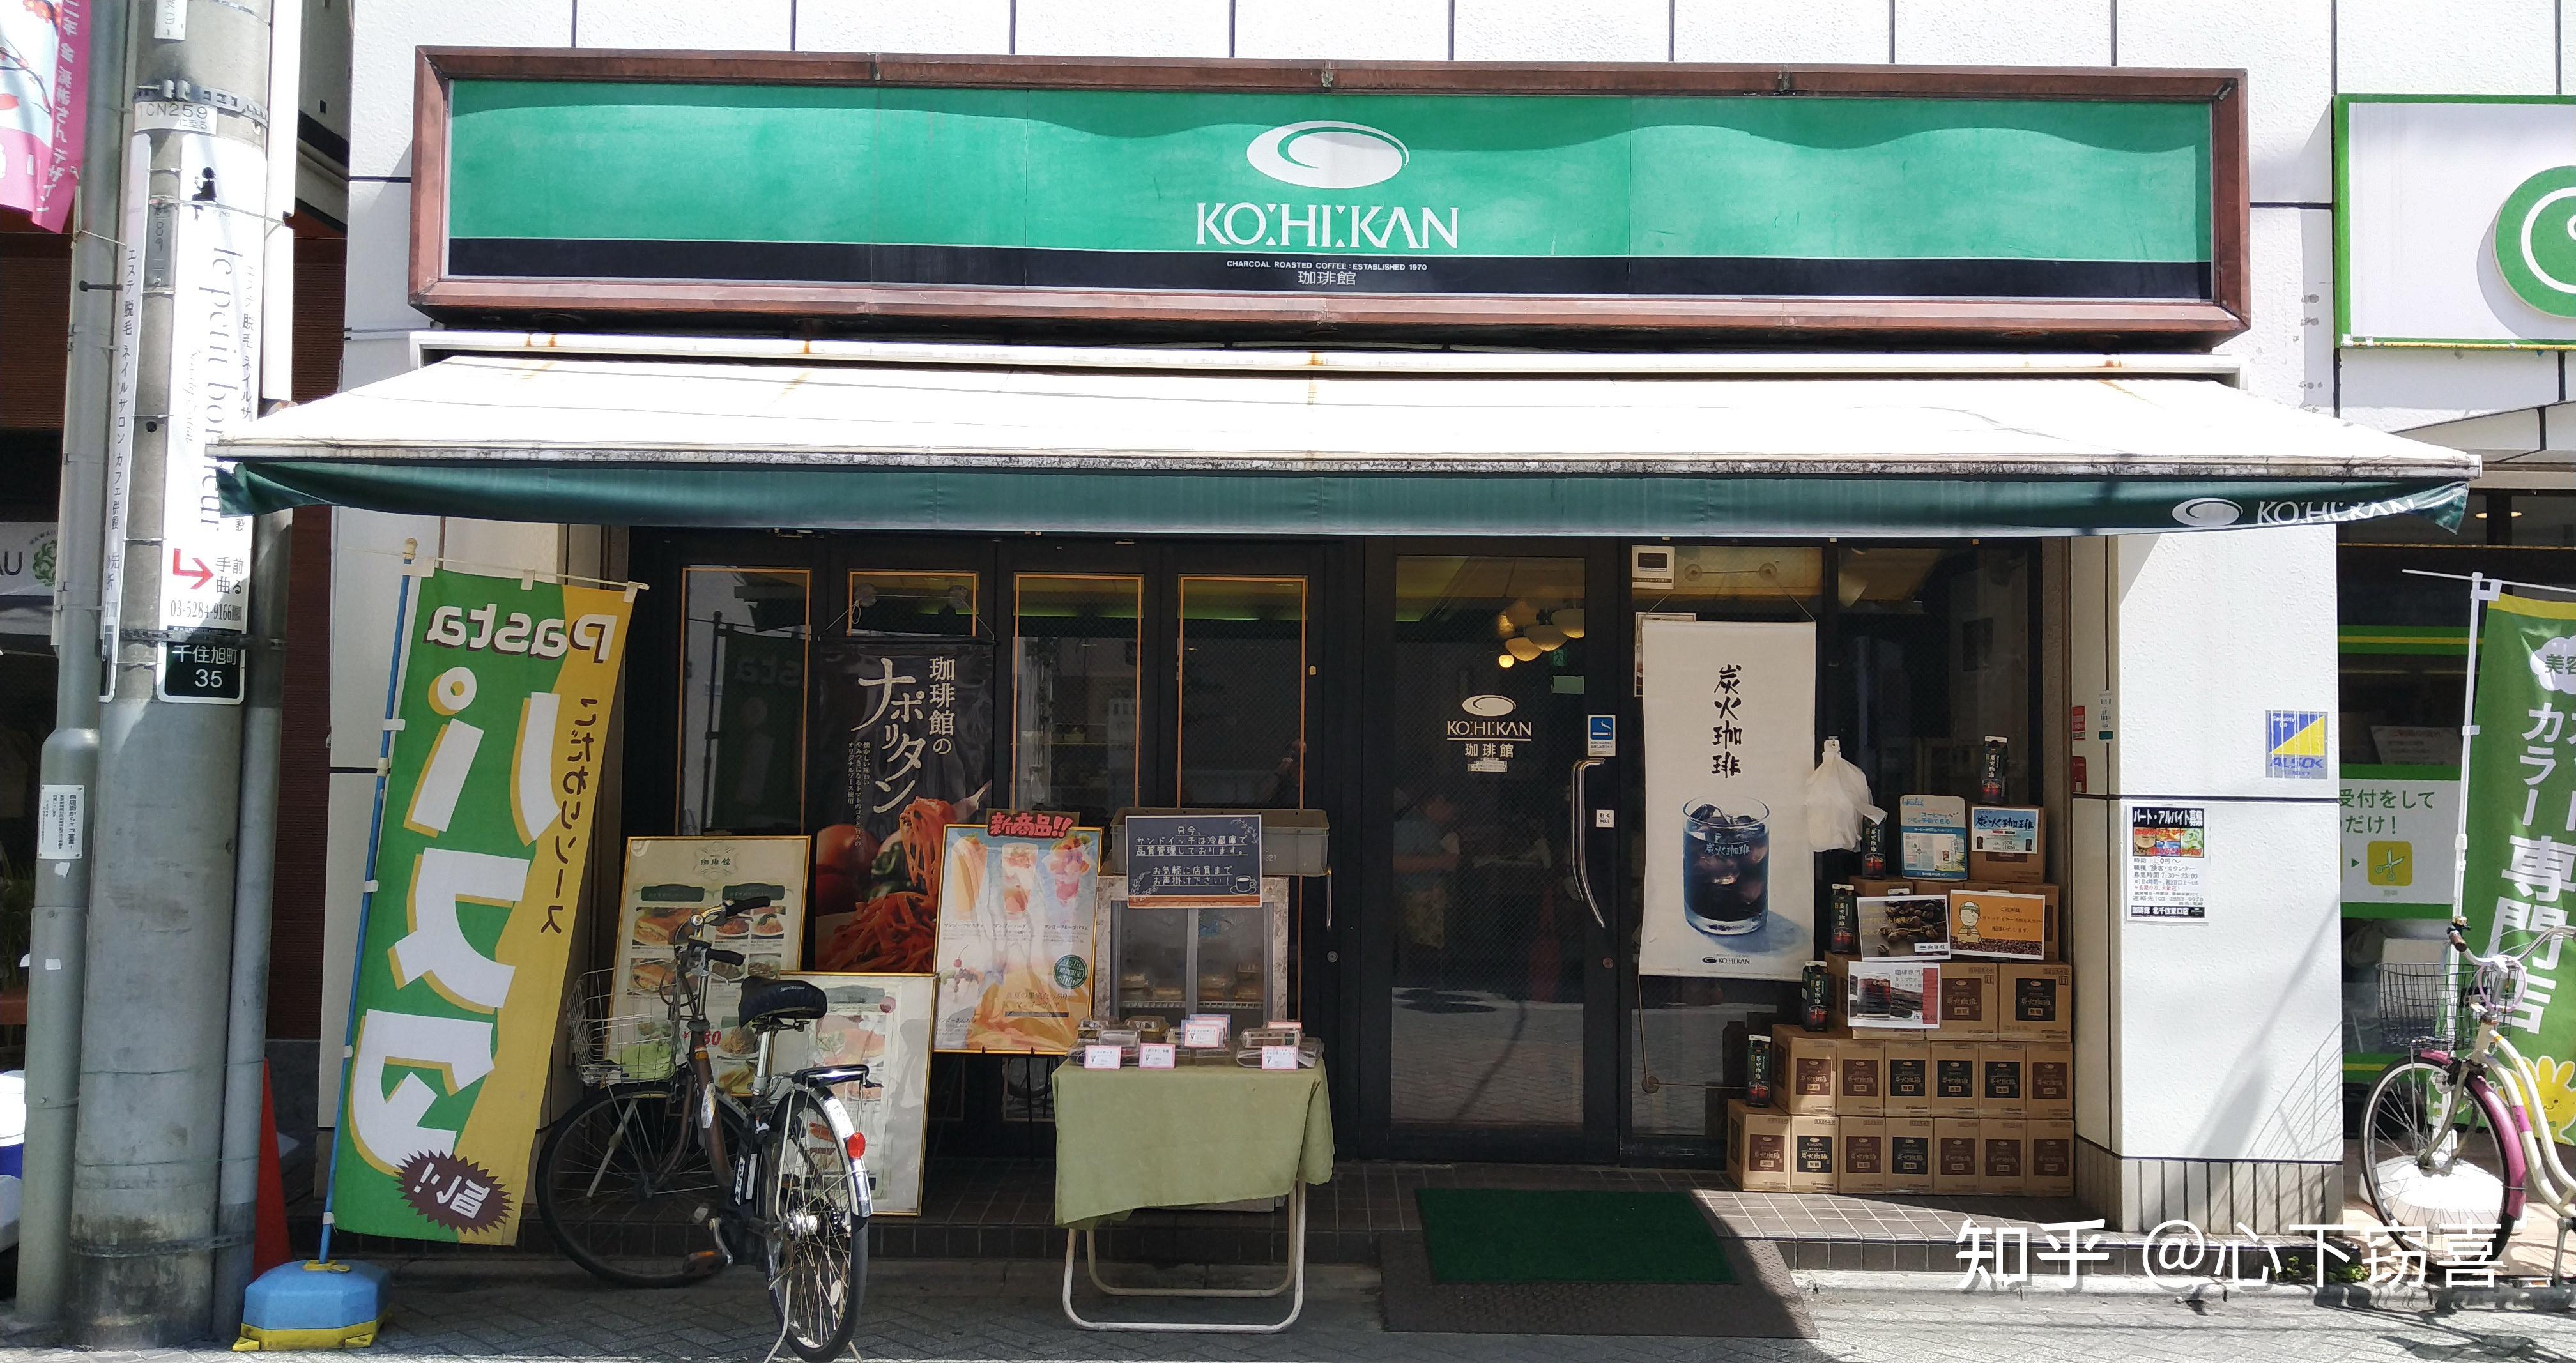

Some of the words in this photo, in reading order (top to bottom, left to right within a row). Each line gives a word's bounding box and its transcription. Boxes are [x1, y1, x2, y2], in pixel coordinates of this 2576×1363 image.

[1227, 260, 1271, 268] CHARCOAL
[1274, 261, 1312, 269] ROASTED
[1315, 262, 1347, 270] COFFEE
[1353, 263, 1406, 271] ESTABLISHED
[1298, 271, 1356, 286] 珈琲館
[122, 249, 137, 337] エステ脱毛
[117, 345, 130, 445] ネイルサロン
[0, 551, 23, 575] U
[215, 557, 243, 575] 手前
[216, 575, 242, 595] 曲る
[171, 644, 238, 666] 千住旭町
[194, 669, 223, 689] 35
[928, 655, 956, 755] 珈琲館の
[1711, 663, 1744, 779] 炭火珈琲
[850, 657, 927, 814] ナポリタン
[1464, 743, 1514, 758] 珈琲館
[2269, 757, 2325, 769] ALSOK
[2339, 788, 2435, 809] 受付をして
[990, 811, 1074, 838] 新商品!!
[1974, 815, 2035, 830] 炭火珈琲
[2339, 815, 2396, 834] だけ!
[1137, 835, 1248, 845] サンドイッチは冷蔵庫で
[1705, 842, 1751, 857] 炭火珈琲
[1136, 846, 1243, 855] 品質管理しております。
[1153, 865, 1233, 875] お気軽に店員まで
